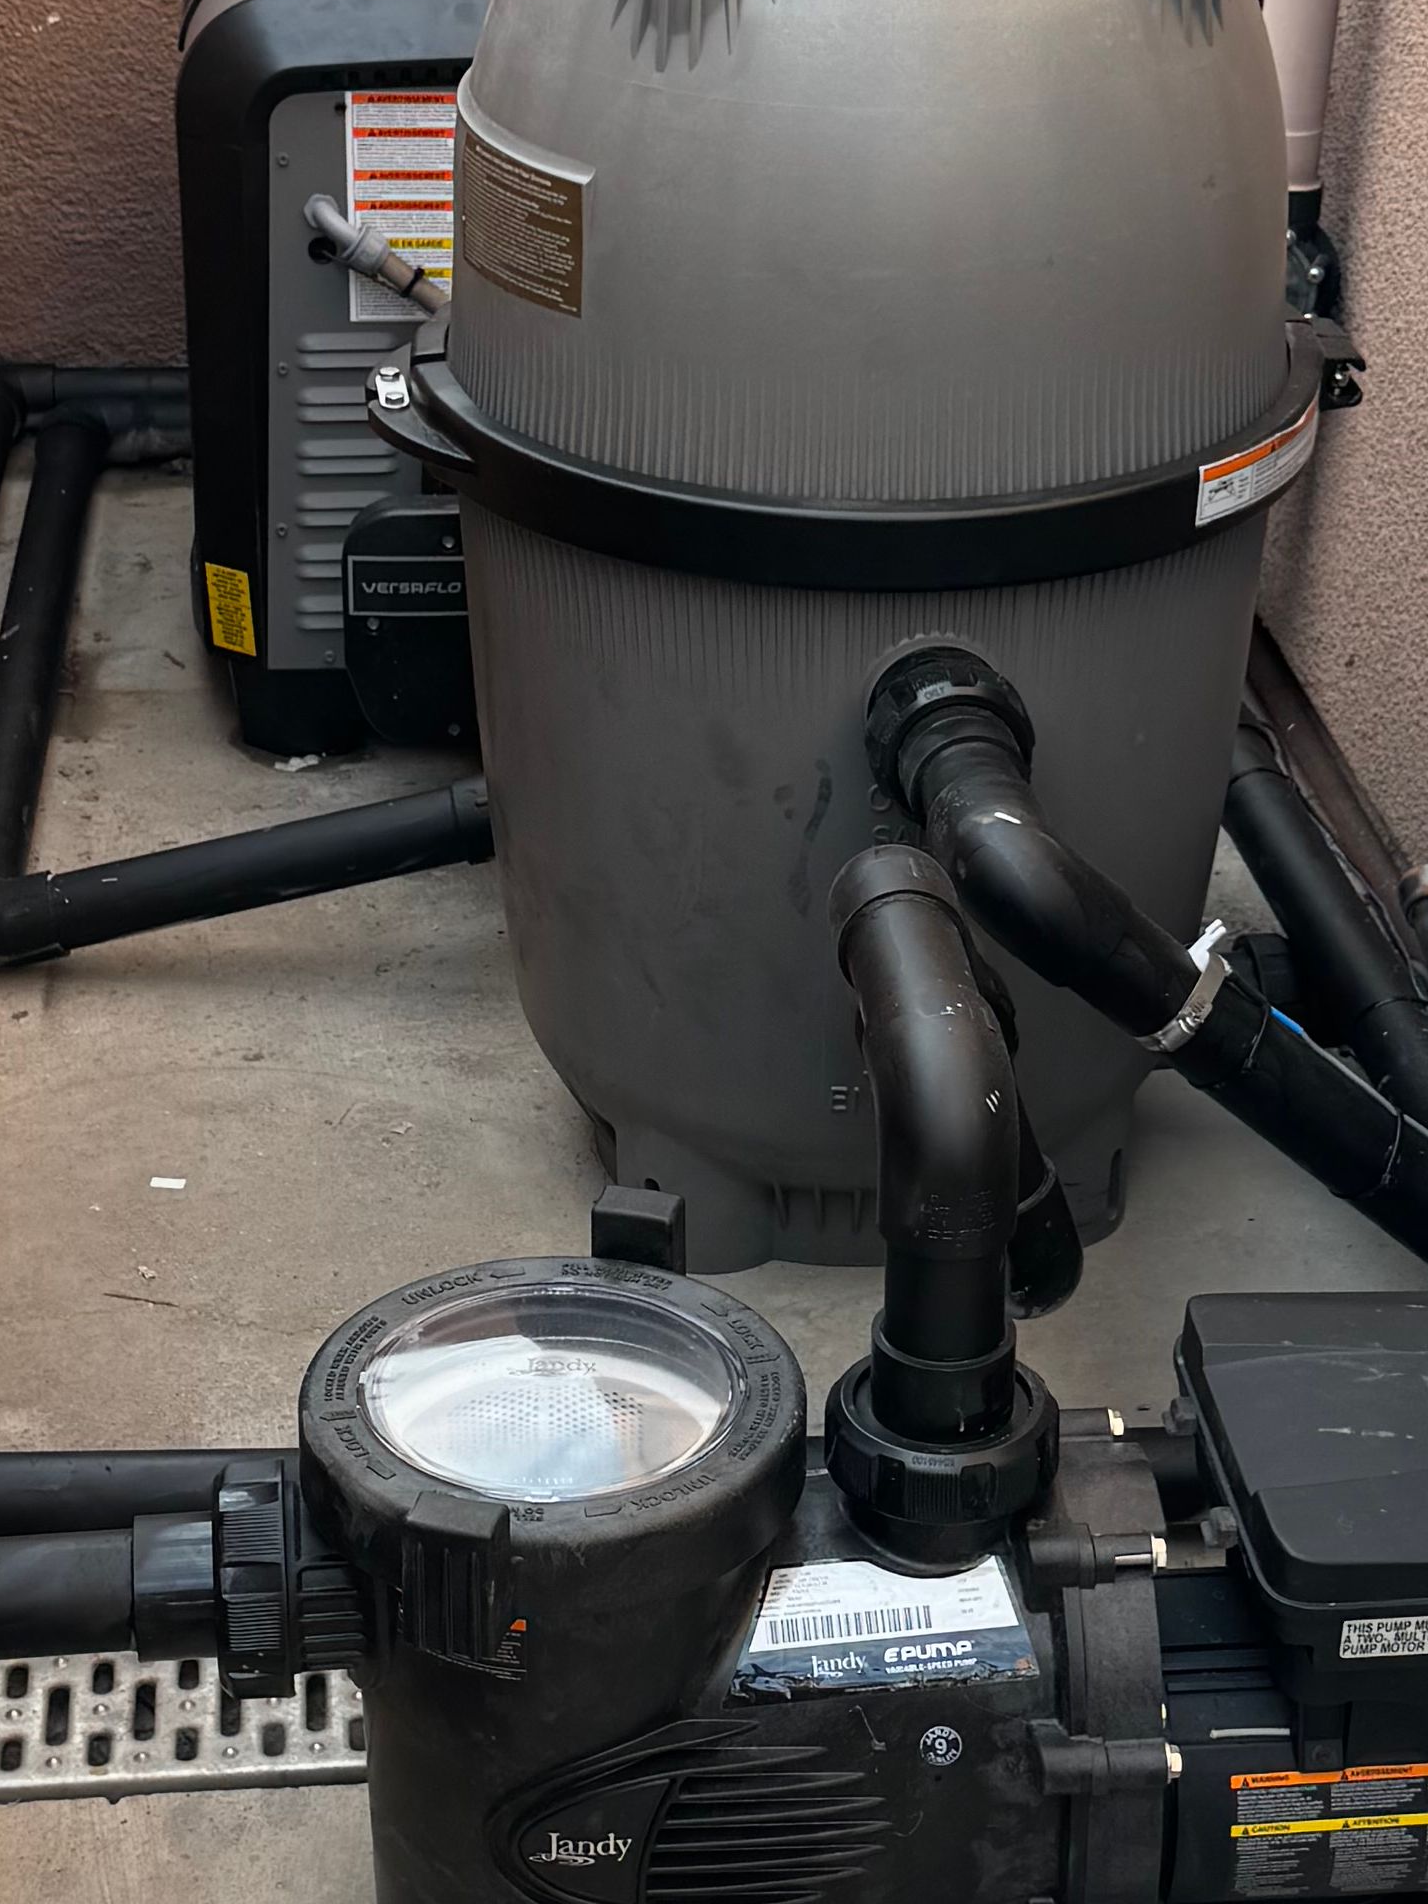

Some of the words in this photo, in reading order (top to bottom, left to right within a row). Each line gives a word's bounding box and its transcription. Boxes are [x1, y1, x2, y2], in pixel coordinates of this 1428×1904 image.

[361, 582, 462, 594] VERSAFLO
[401, 1269, 483, 1305] UNLOCK
[726, 1319, 765, 1350] LOCK
[512, 1358, 595, 1376] Jandy
[630, 1474, 717, 1511] UNLOCK
[1347, 1623, 1374, 1634] THIS
[1376, 1621, 1412, 1632] PUMP
[1342, 1643, 1378, 1655] PUMP
[1380, 1641, 1425, 1653] MOTOR
[1343, 1635, 1352, 1644] A
[810, 1651, 867, 1678] Jandy
[935, 1738, 947, 1755] 9
[1251, 1824, 1291, 1834] CAUTION
[1352, 1816, 1400, 1827] ATTENTION
[535, 1832, 632, 1864] Jandy
